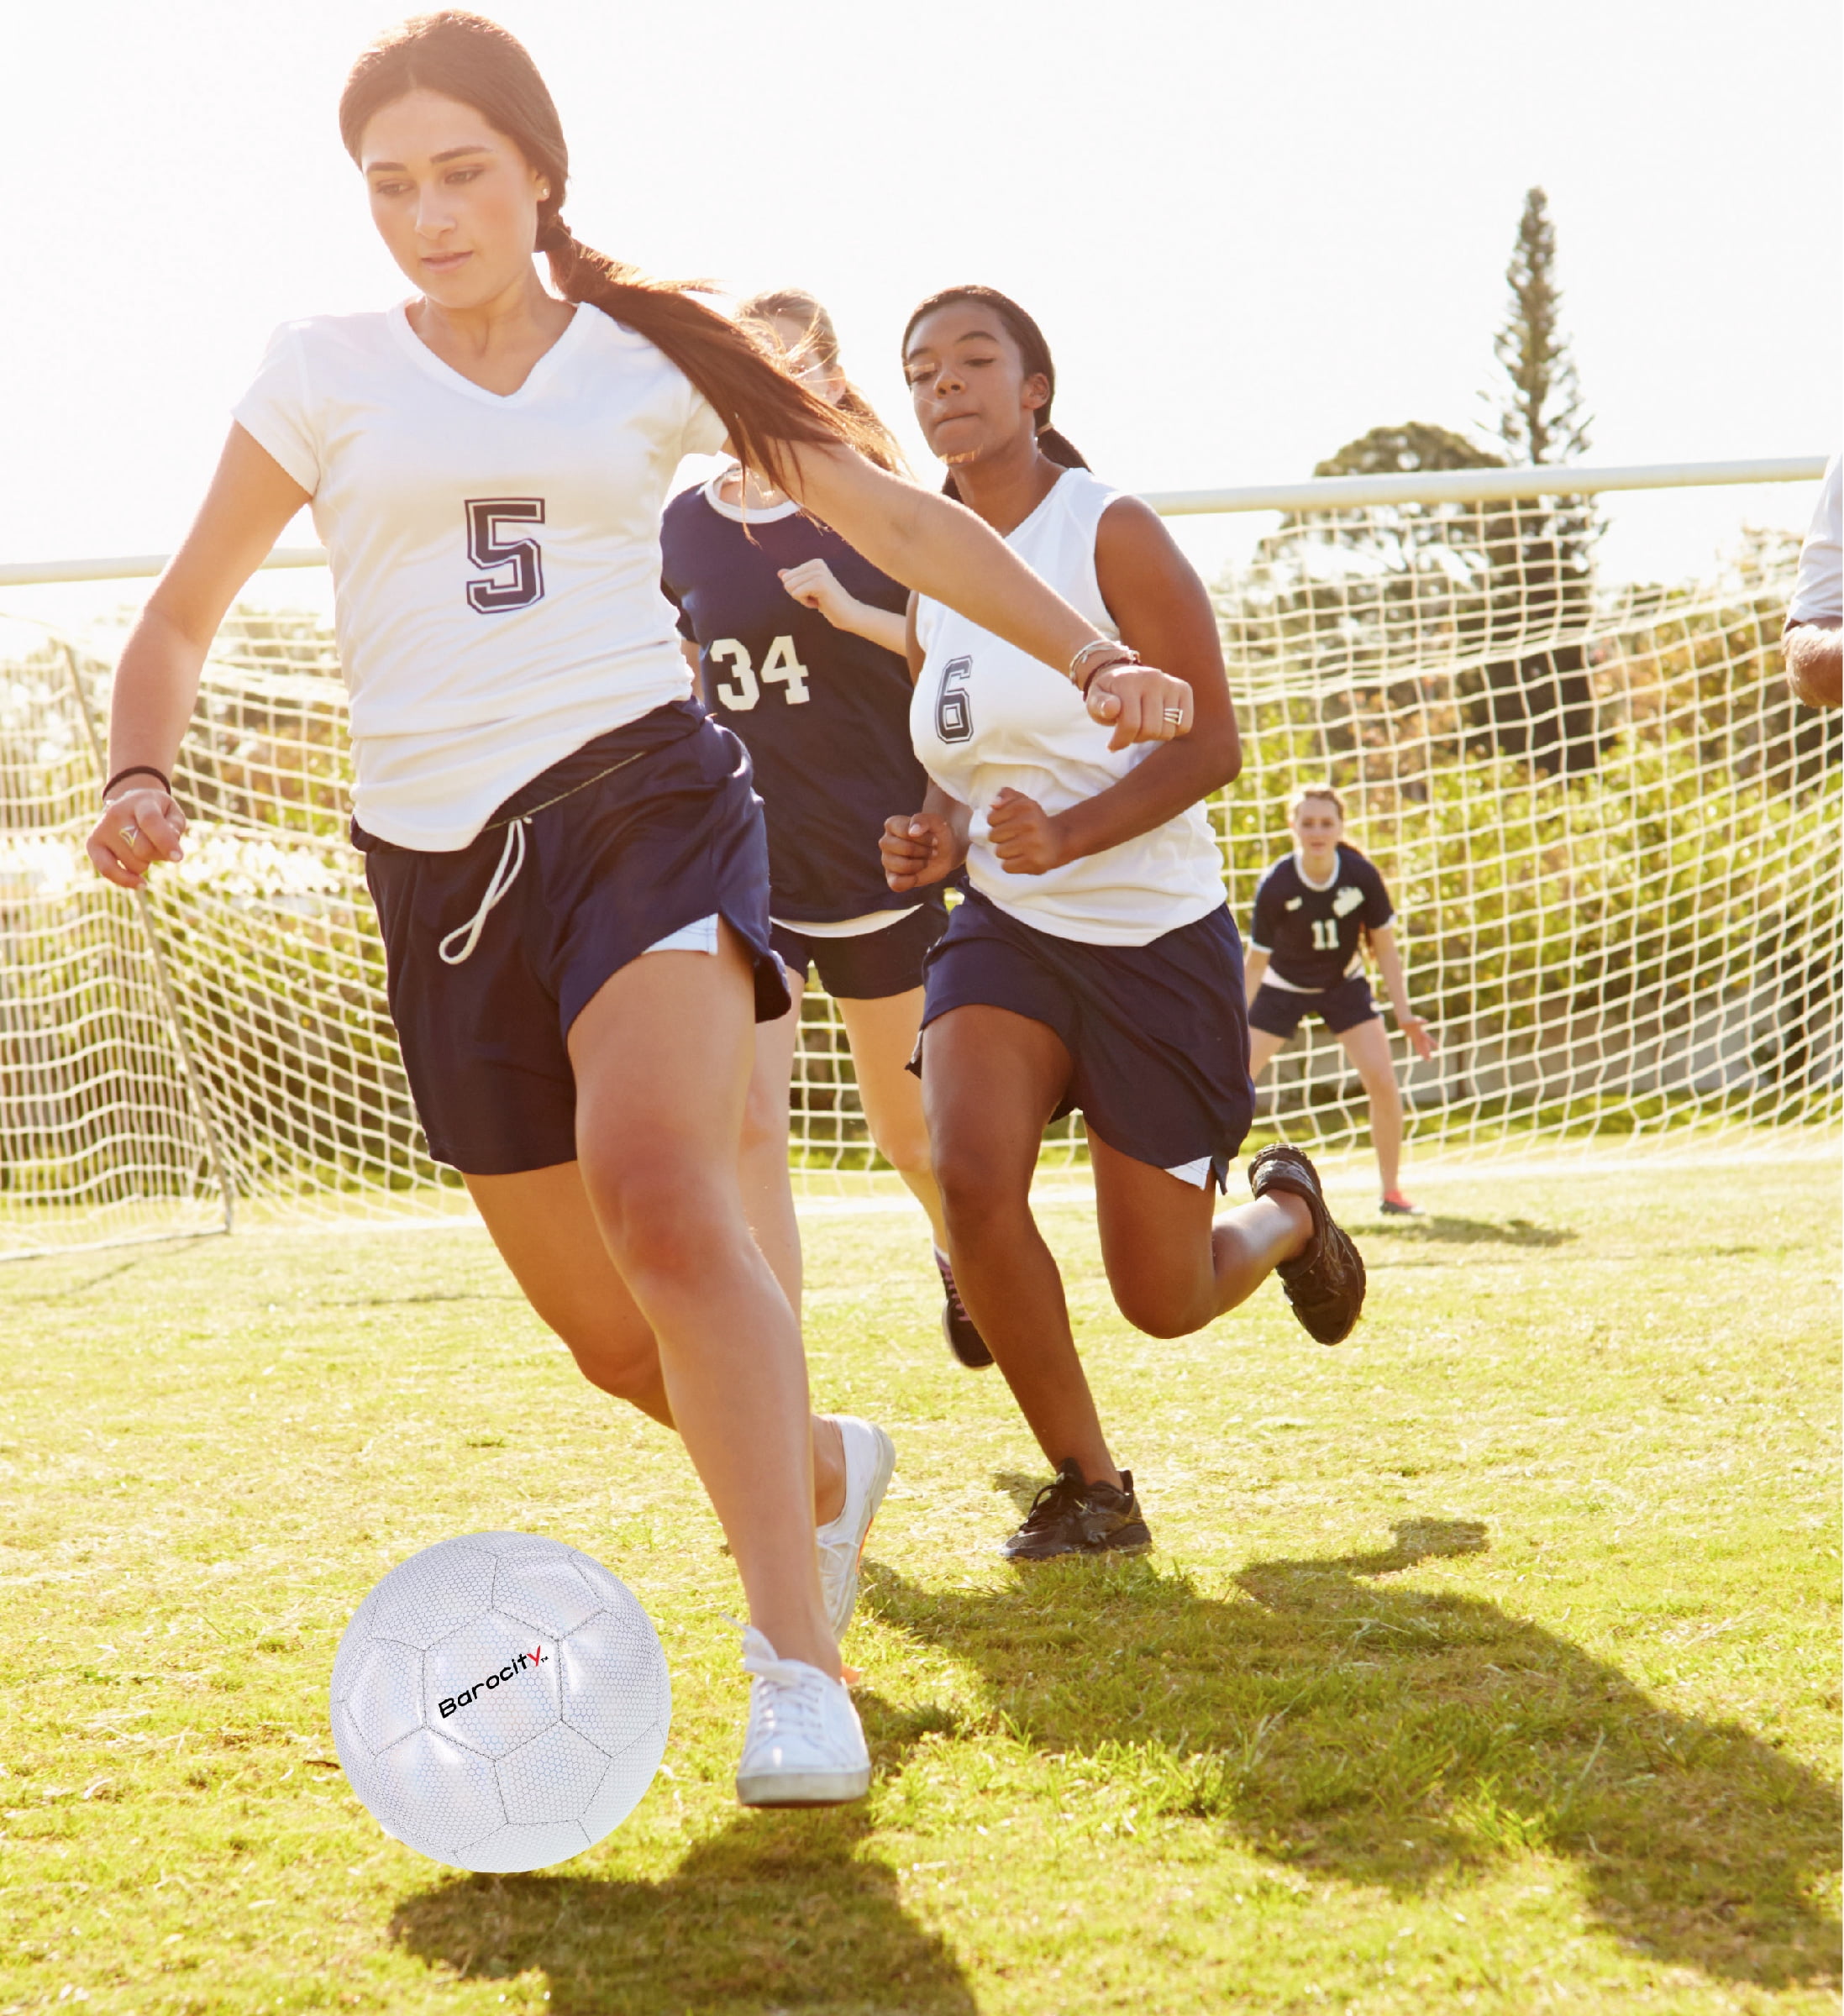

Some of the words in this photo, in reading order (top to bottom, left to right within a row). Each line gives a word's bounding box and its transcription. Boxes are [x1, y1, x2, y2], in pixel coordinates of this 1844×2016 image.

[464, 497, 545, 614] 5
[709, 635, 810, 711] 34
[935, 655, 975, 744] 6
[1311, 919, 1339, 950] 11
